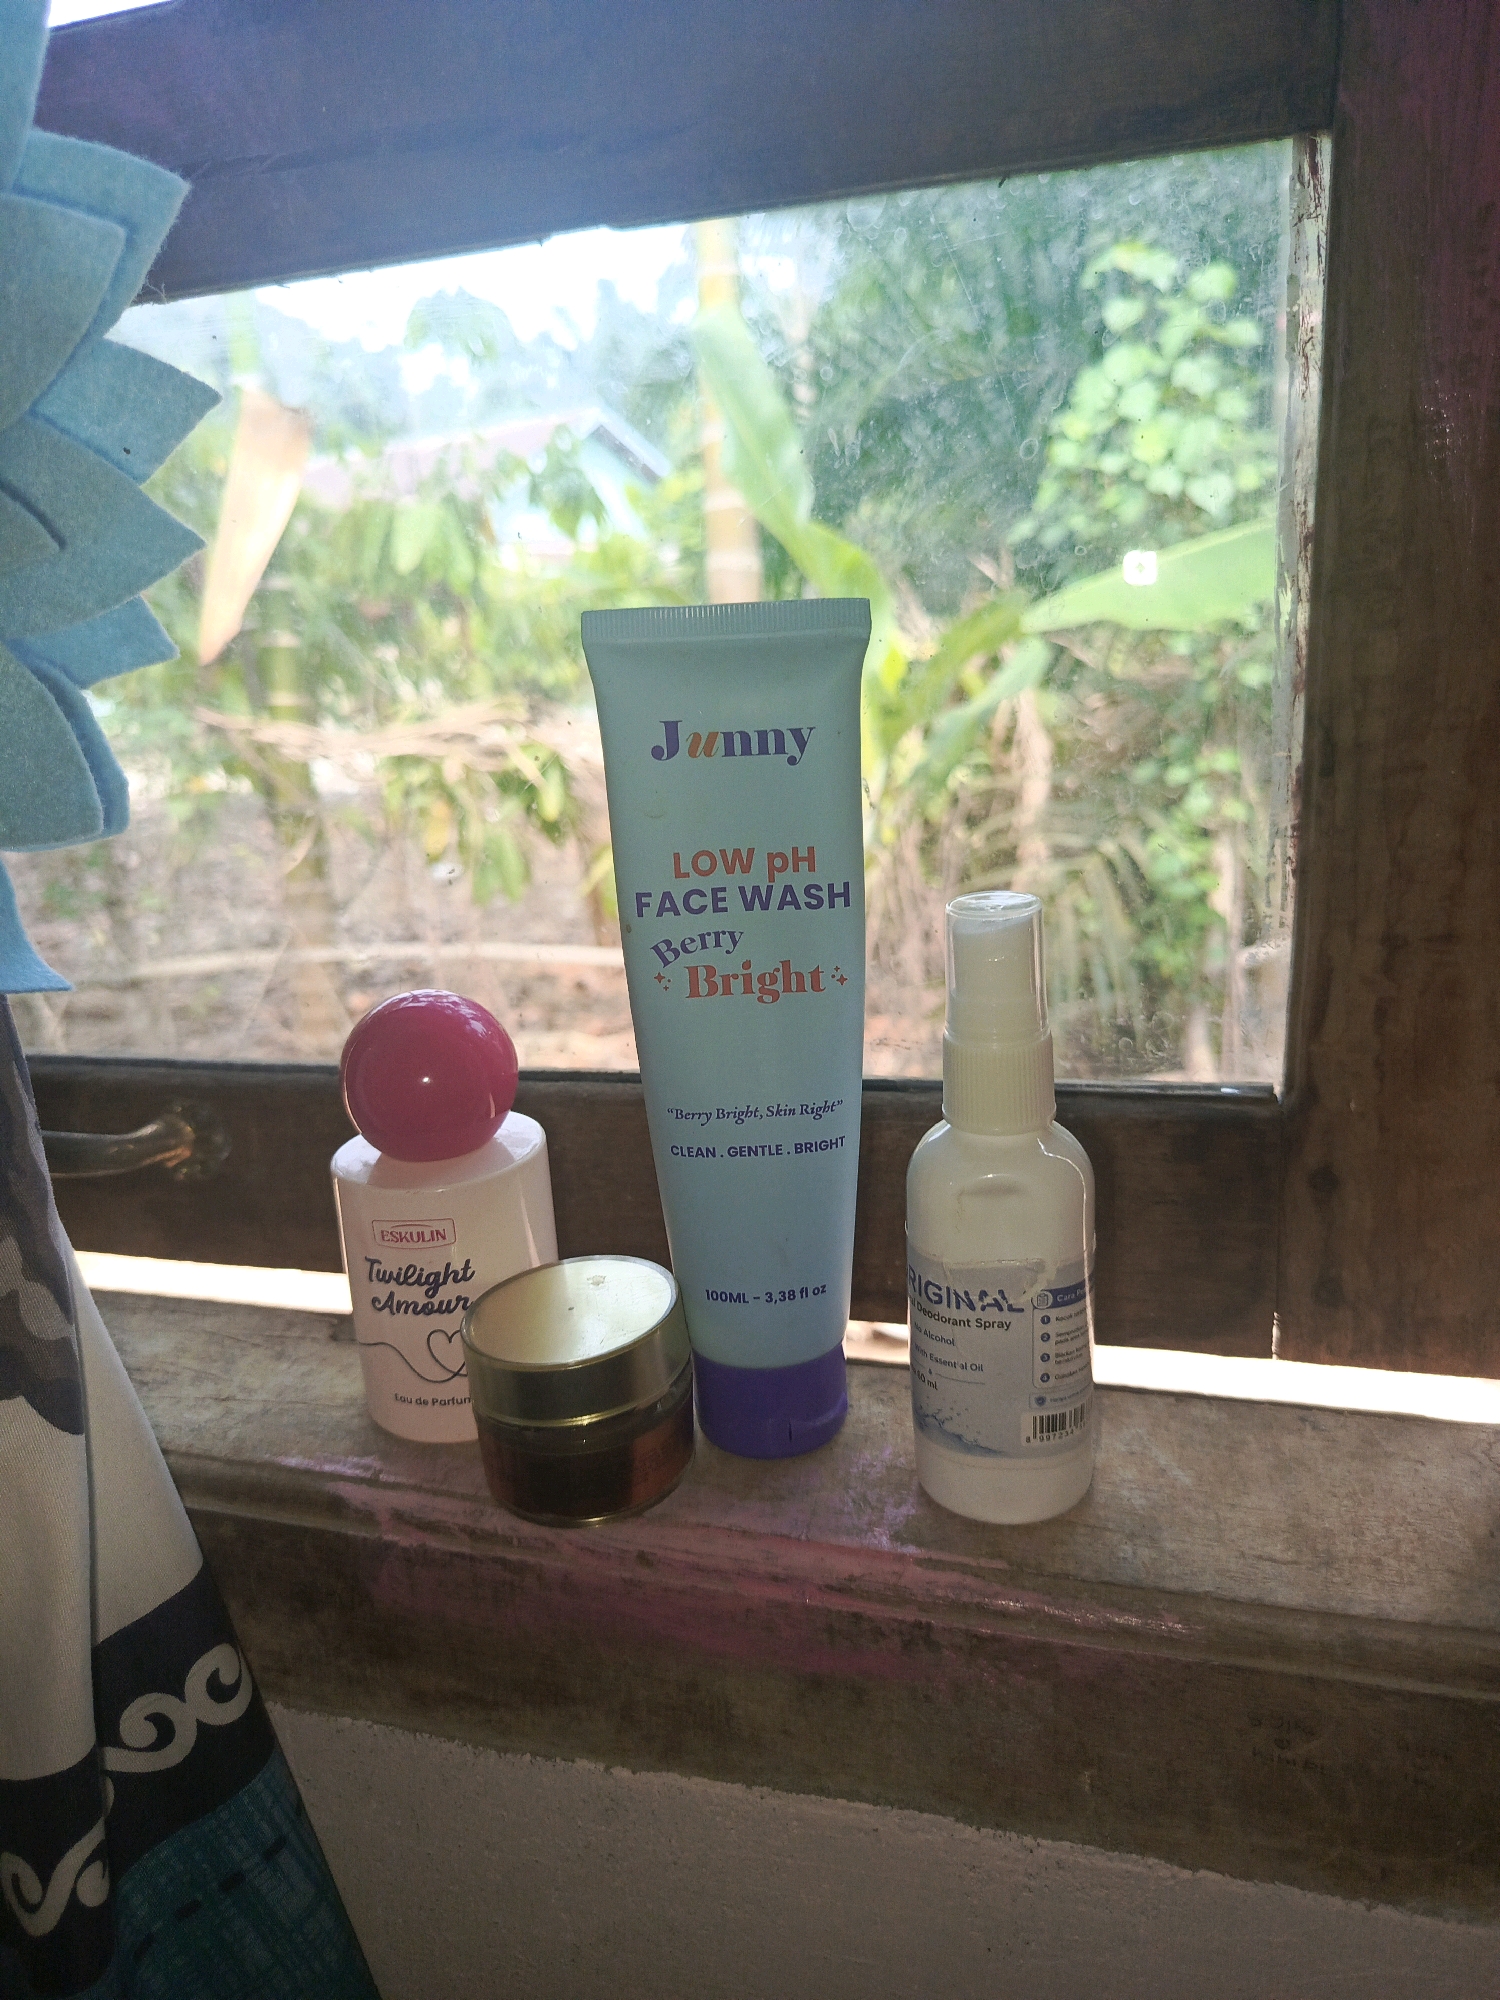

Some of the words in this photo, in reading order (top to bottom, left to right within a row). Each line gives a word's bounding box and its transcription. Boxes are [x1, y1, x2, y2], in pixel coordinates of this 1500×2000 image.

[651, 720, 816, 766] Junny
[673, 847, 755, 879] LOW
[767, 846, 816, 883] pH
[635, 886, 729, 917] FACE
[738, 881, 851, 912] WASH
[650, 930, 744, 968] Berry
[684, 959, 826, 1004] Bright
[715, 1104, 763, 1125] Bright,
[766, 1103, 796, 1118] Skin
[670, 1145, 716, 1158] CLEAN
[727, 1144, 783, 1157] GENTLE
[794, 1136, 846, 1155] BRIGHT
[381, 1228, 447, 1243] ESKULIN
[365, 1256, 475, 1298] Twilight
[908, 1264, 1025, 1313] RIGINAL
[371, 1290, 474, 1315] Amour
[705, 1289, 749, 1304] 100ML
[765, 1289, 796, 1305] 3,38
[799, 1287, 809, 1299] fl
[812, 1284, 827, 1296] oz
[917, 1300, 971, 1328] Deodorant
[975, 1318, 1011, 1331] Spray
[924, 1328, 955, 1346] Alcohol
[929, 1352, 968, 1370] Essental
[970, 1362, 984, 1372] Oil
[394, 1393, 412, 1404] Eau
[415, 1397, 429, 1406] de
